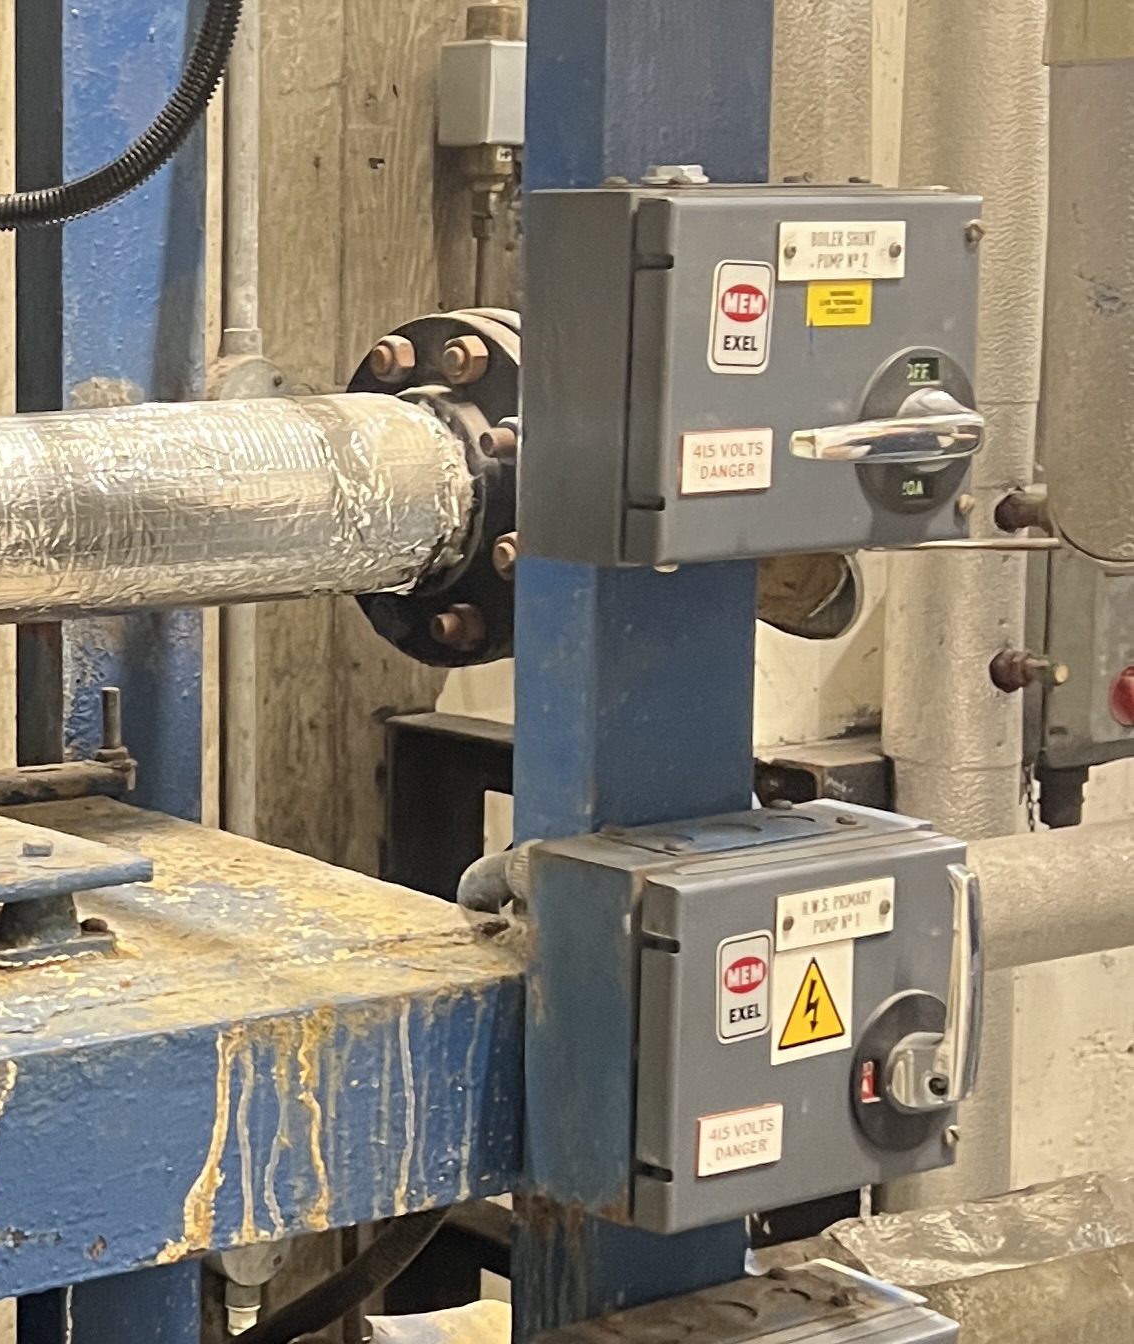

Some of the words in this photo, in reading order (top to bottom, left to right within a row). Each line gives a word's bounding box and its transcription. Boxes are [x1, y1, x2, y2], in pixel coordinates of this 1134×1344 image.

[817, 253, 844, 269] PUMP
[723, 291, 764, 315] MEM
[723, 334, 758, 352] EXEL
[692, 444, 716, 459] 415
[720, 441, 763, 458] VOLTS
[700, 462, 755, 480] DANGER
[813, 916, 839, 934] PUMP
[726, 962, 764, 990] MEM
[729, 1003, 761, 1024] EXEL
[708, 1125, 730, 1142] 415
[734, 1117, 775, 1137] VOLTS
[715, 1138, 768, 1161] DANGER
